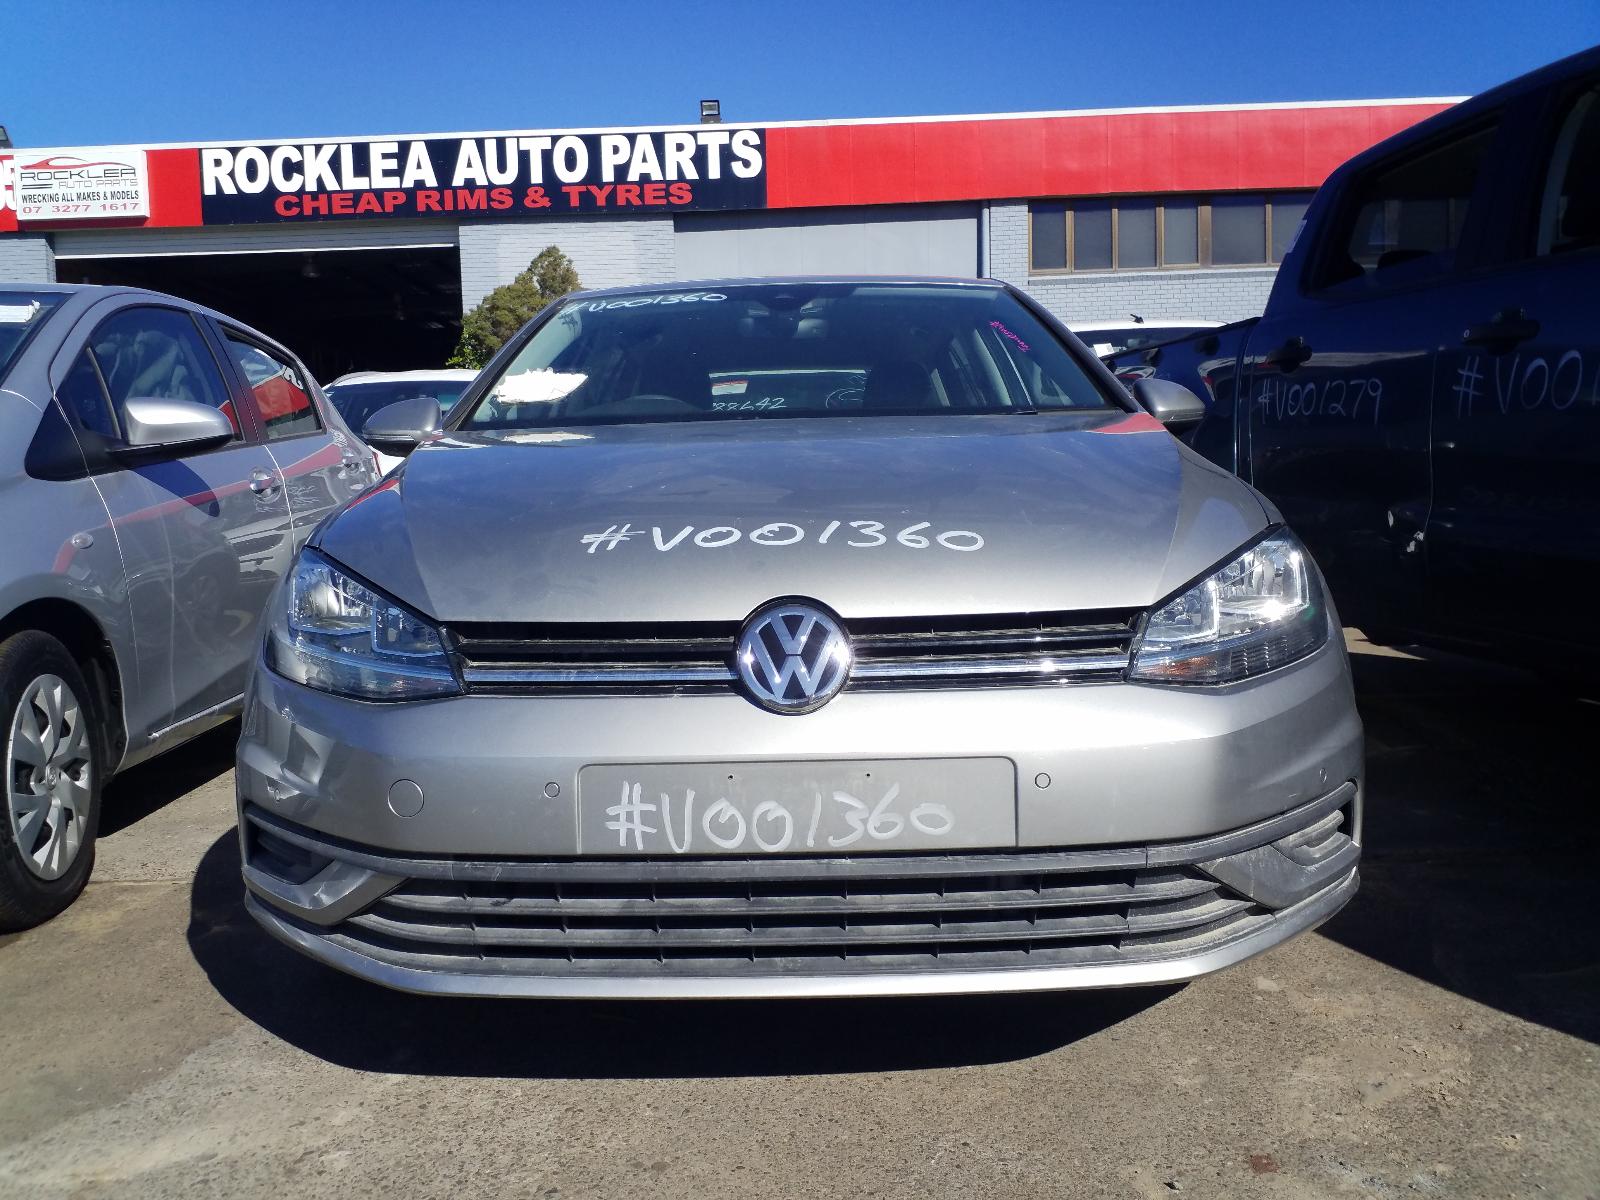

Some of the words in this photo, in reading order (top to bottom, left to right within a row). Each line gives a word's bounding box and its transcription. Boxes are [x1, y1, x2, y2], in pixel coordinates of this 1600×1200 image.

[20, 168, 137, 181] ROCKLEA
[201, 141, 437, 196] ROCKLEA
[451, 135, 589, 186] AUTO
[601, 130, 764, 183] PARTS
[21, 193, 60, 204] WRECKING
[61, 192, 75, 203] ALL
[76, 191, 101, 202] MAKES
[110, 190, 139, 200] MODELS
[58, 180, 93, 189] AUTO
[96, 178, 138, 188] PARTS
[275, 191, 407, 217] CHEAP
[423, 187, 514, 212] RIMS
[524, 186, 552, 208] &
[561, 182, 693, 207] TYRES
[22, 206, 42, 214] 07
[51, 204, 91, 213] 3277
[99, 202, 140, 211] 1617
[1257, 377, 1383, 424] #V001279
[579, 519, 985, 554] #V001360
[604, 781, 955, 853] #V001360
